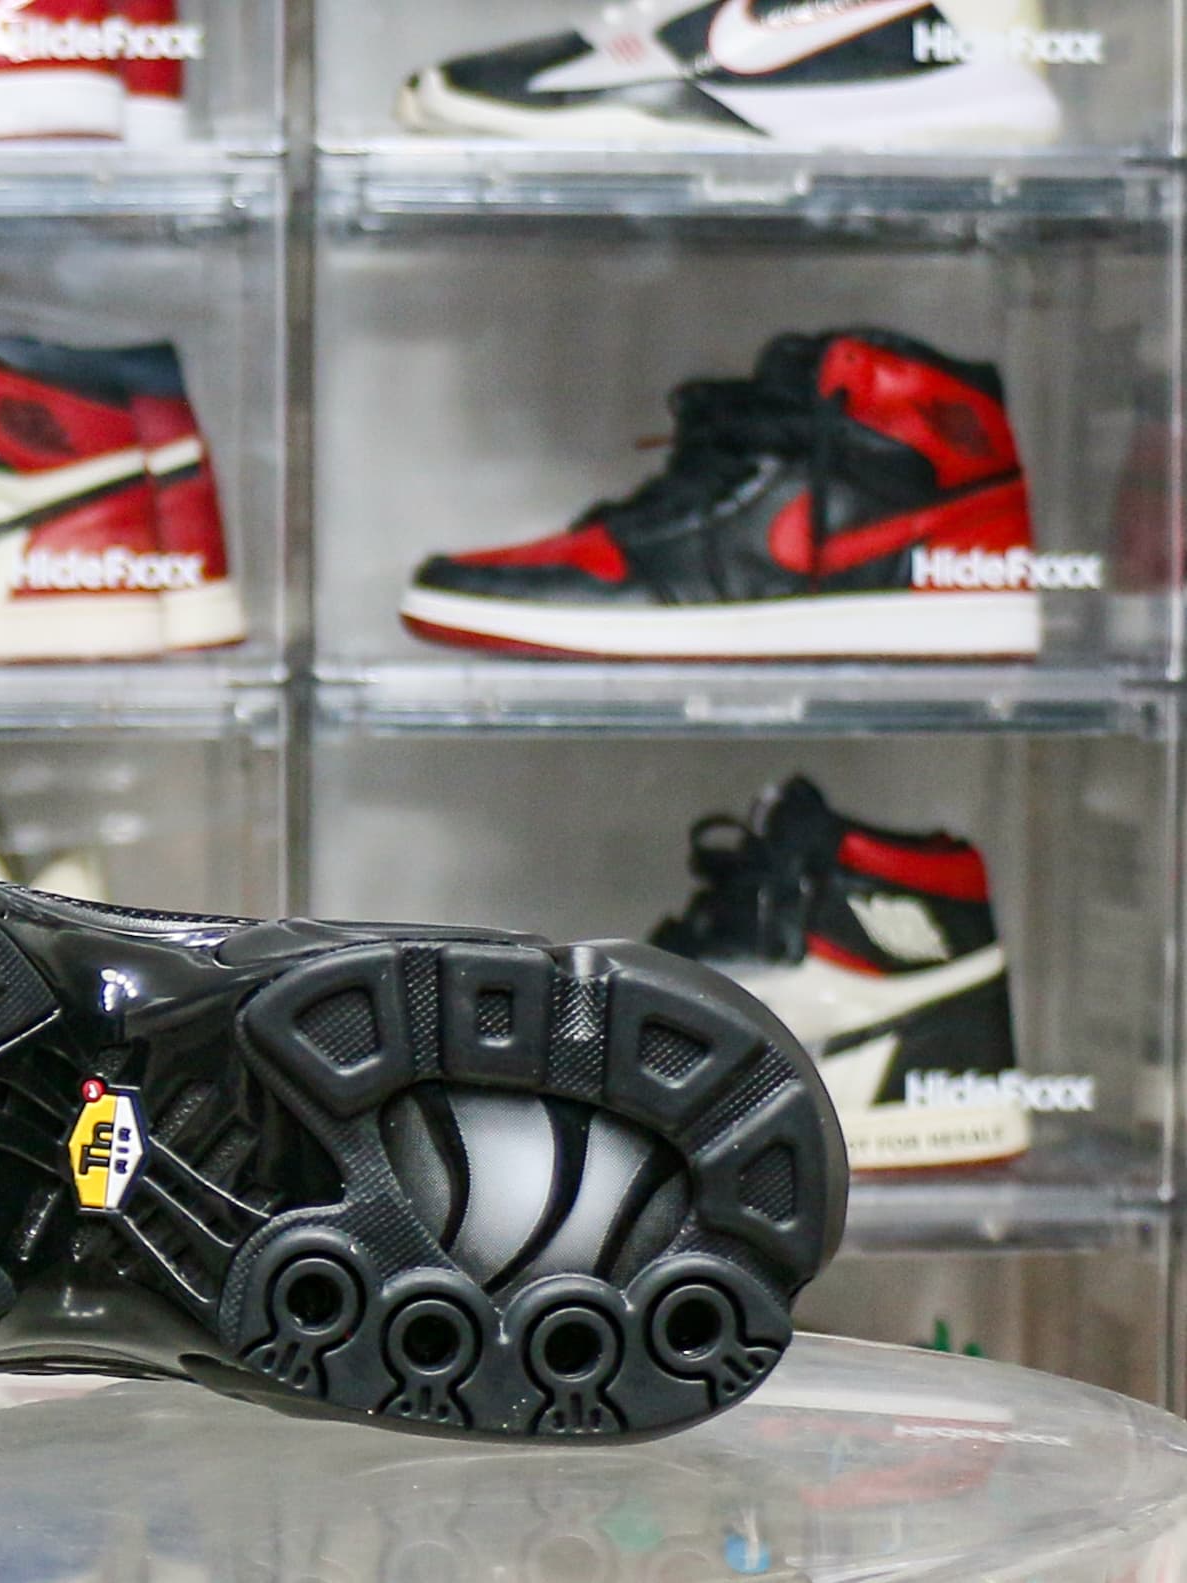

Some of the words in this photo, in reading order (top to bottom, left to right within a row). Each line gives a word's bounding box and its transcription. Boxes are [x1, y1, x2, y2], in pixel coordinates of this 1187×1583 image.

[912, 546, 1101, 590] HideFxxx
[905, 1069, 1096, 1111] HideFxxx
[79, 1121, 114, 1175] Tn
[115, 1127, 132, 1175] AIR
